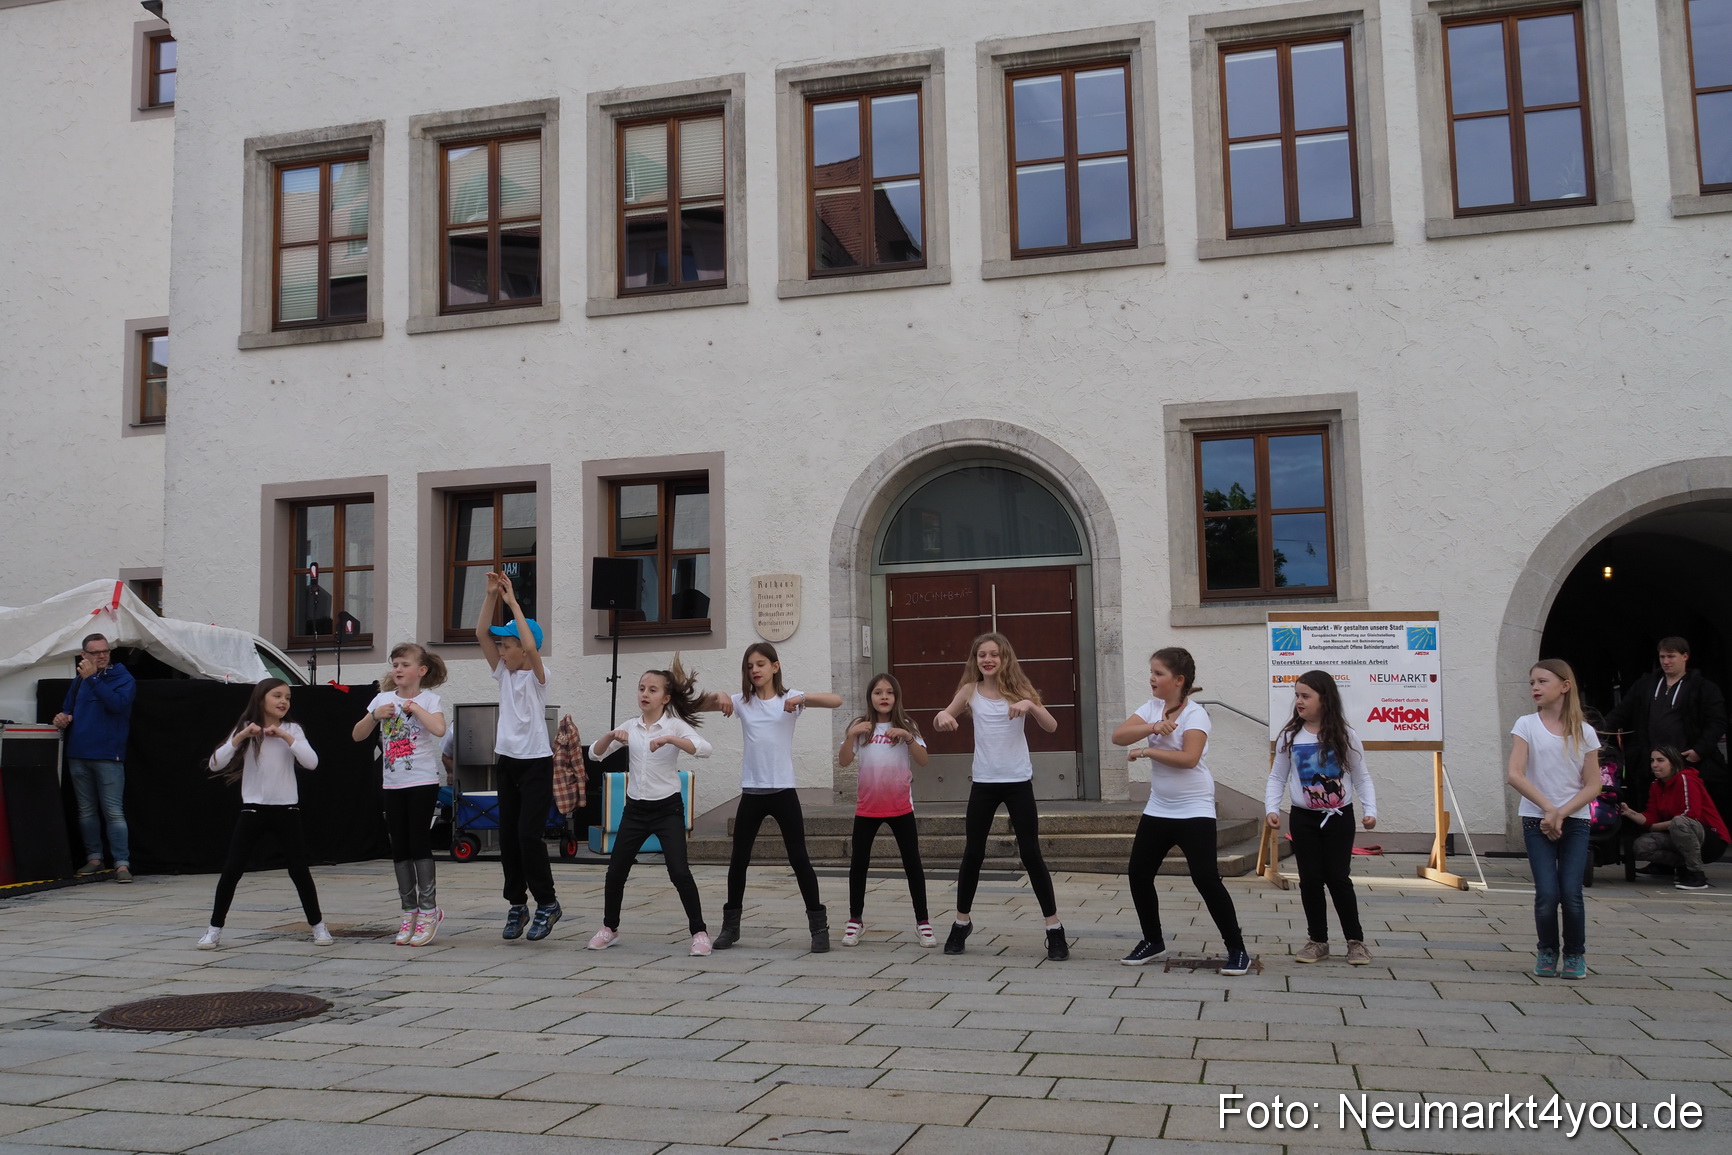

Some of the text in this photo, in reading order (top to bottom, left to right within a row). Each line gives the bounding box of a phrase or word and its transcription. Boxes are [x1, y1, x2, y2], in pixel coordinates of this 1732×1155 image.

[757, 580, 794, 589] Rathaus
[1344, 624, 1369, 633] gestalten
[1389, 623, 1404, 631] Stadt
[1369, 673, 1427, 683] NEUMARKT
[1393, 723, 1430, 731] MENSCH
